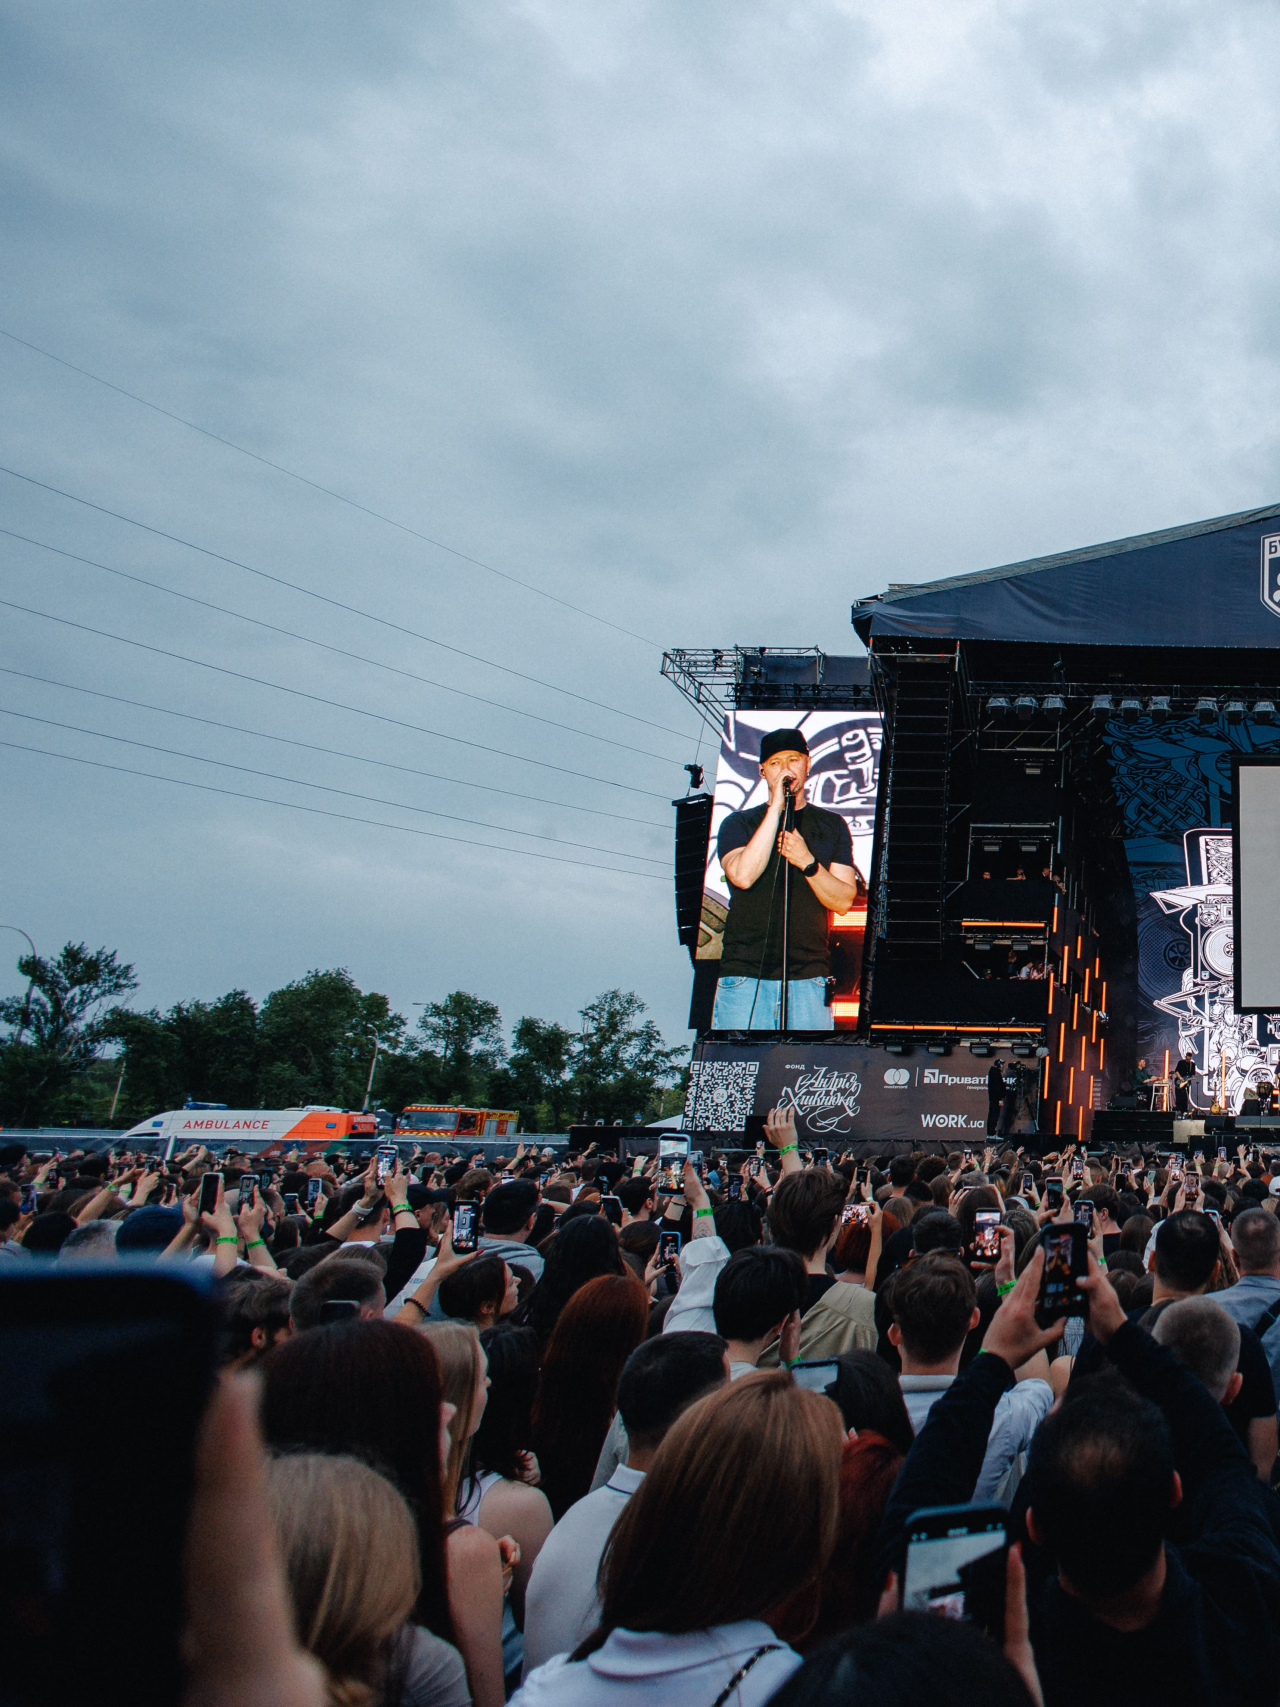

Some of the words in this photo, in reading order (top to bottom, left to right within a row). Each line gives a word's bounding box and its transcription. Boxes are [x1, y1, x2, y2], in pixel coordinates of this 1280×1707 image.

[938, 1074, 1017, 1086] Приватнк
[182, 1120, 270, 1130] AMBULANCE
[920, 1114, 985, 1128] WORK.ua
